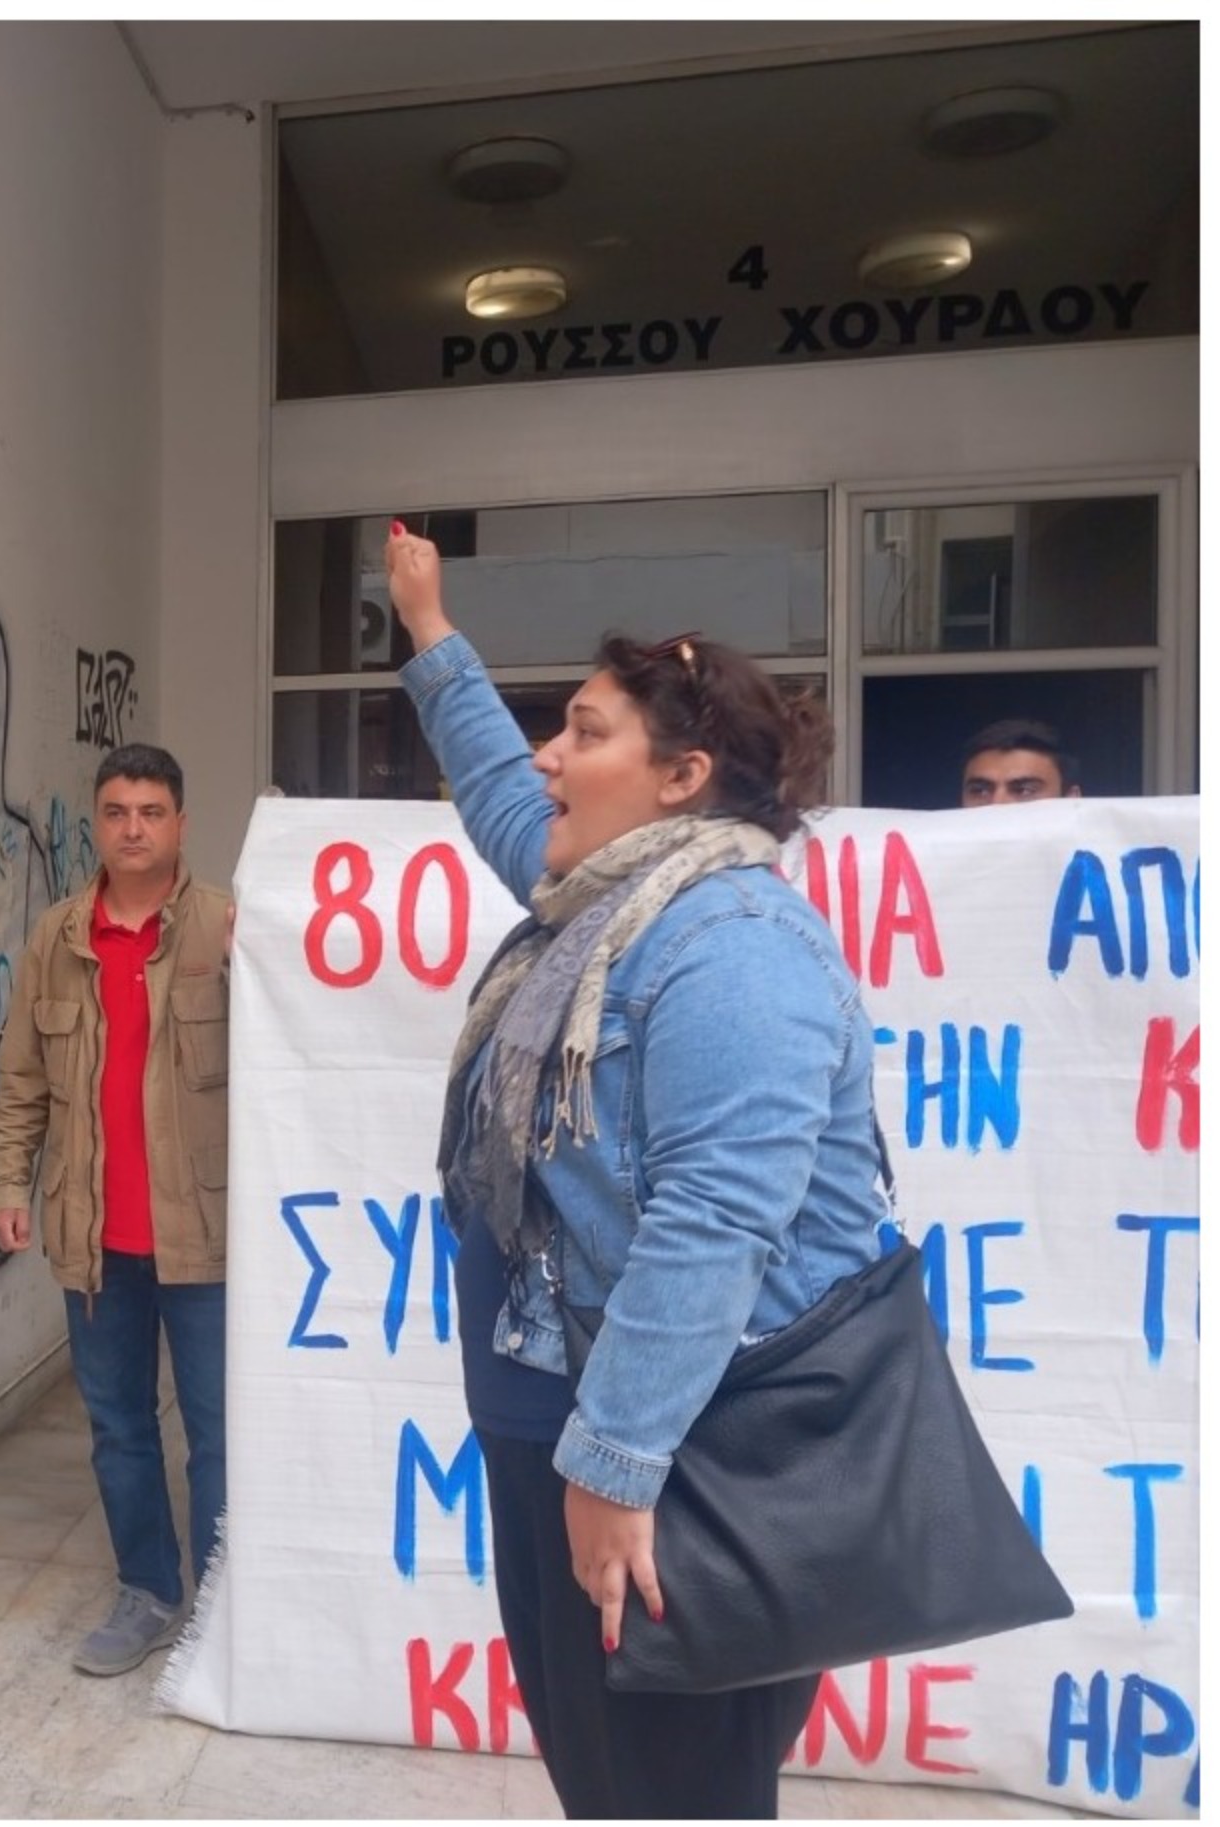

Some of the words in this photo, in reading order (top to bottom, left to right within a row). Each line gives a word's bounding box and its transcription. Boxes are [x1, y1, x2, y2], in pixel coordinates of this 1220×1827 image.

[727, 246, 769, 290] 4
[442, 317, 722, 377] ΡΟΥΣΣΟΥ
[779, 281, 1149, 355] ΧΟΥΡΔΟΥ
[304, 840, 470, 990] 80
[1048, 847, 1201, 981] ΑΠ
